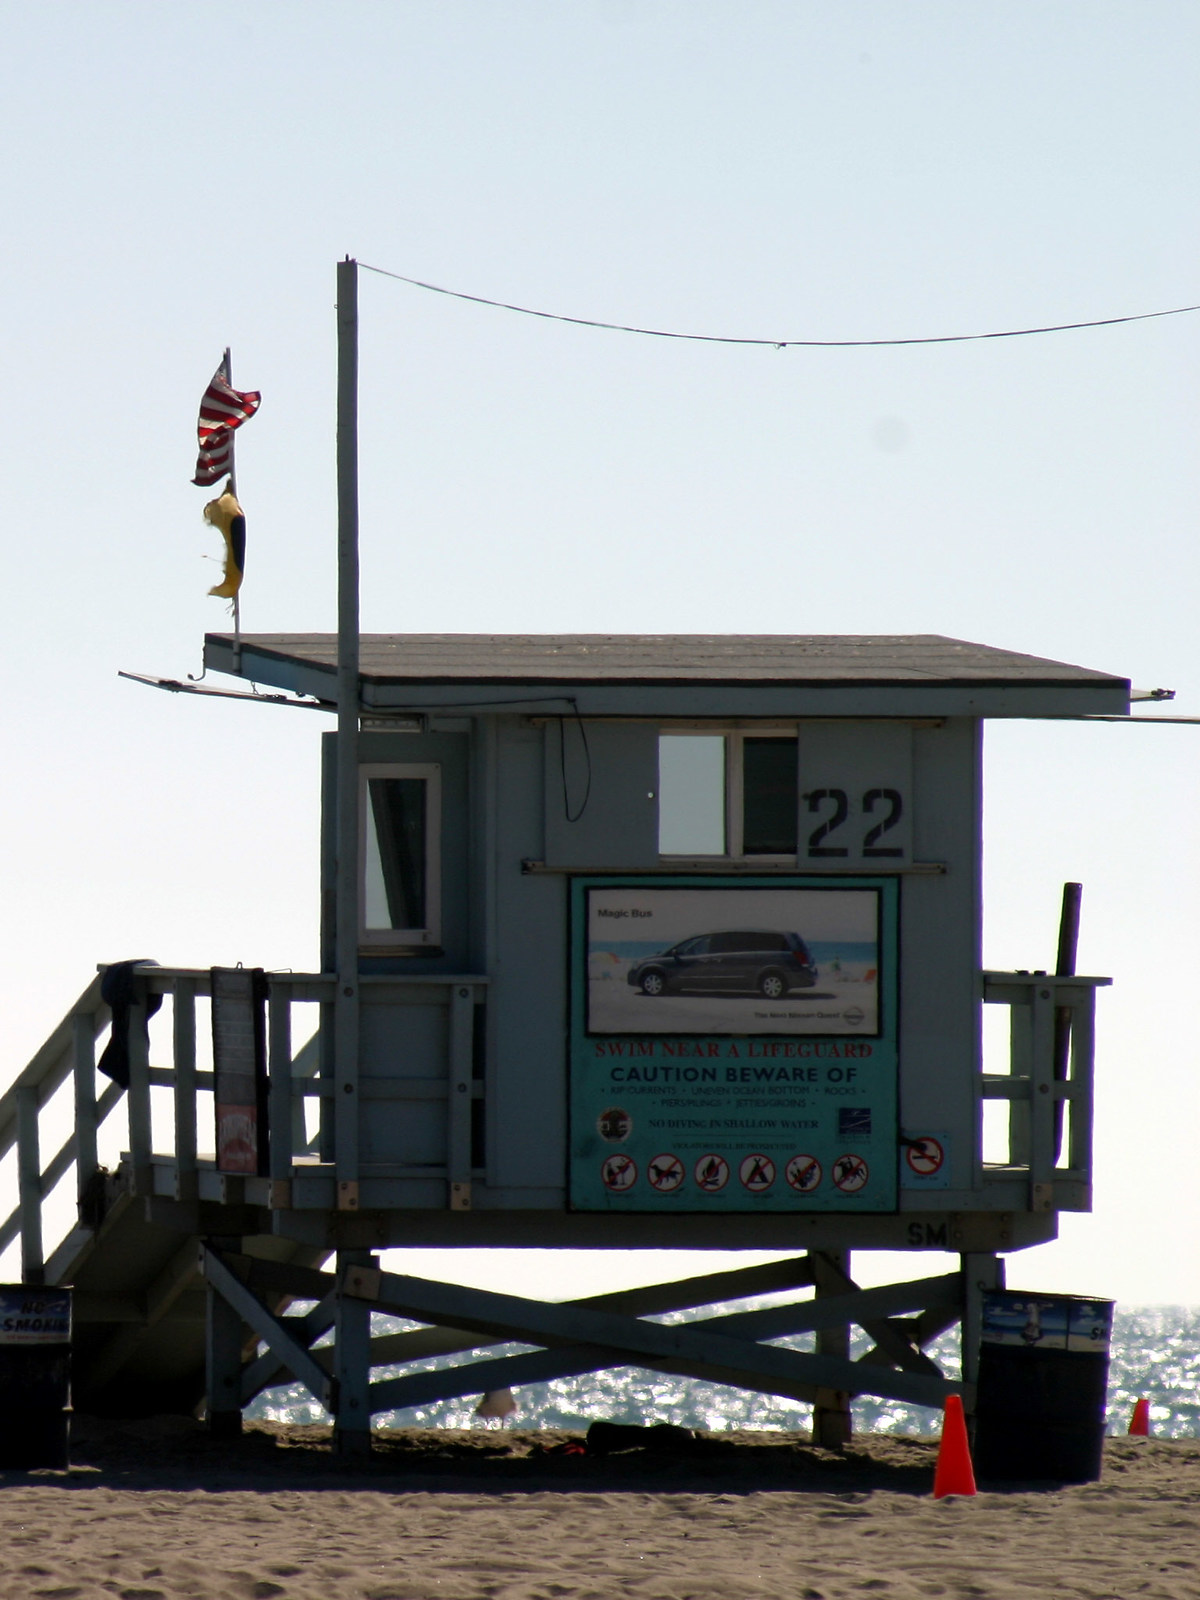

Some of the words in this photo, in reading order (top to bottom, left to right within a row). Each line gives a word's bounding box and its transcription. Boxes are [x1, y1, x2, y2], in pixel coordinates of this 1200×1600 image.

[807, 788, 904, 858] 22
[597, 908, 629, 919] Magic
[631, 908, 653, 918] Bus
[595, 1041, 654, 1058] SWIM
[661, 1041, 720, 1058] NEAR
[727, 1042, 740, 1058] A
[748, 1041, 873, 1058] LIFEGUARD
[610, 1066, 717, 1083] CAUTION
[726, 1066, 818, 1083] BEWARE
[827, 1066, 857, 1083] OF
[610, 1086, 628, 1095] RIP
[629, 1086, 677, 1096] CURRENTS
[691, 1086, 730, 1096] UNEVEN
[732, 1086, 765, 1095] OCEAN
[768, 1086, 810, 1095] BOTTOM
[824, 1086, 857, 1096] ROCKS
[648, 1119, 665, 1129] NO
[667, 1119, 707, 1129] DIVING
[709, 1119, 722, 1129] IN
[724, 1118, 778, 1129] SHALLOW
[780, 1118, 820, 1129] WATER
[907, 1221, 948, 1246] SM
